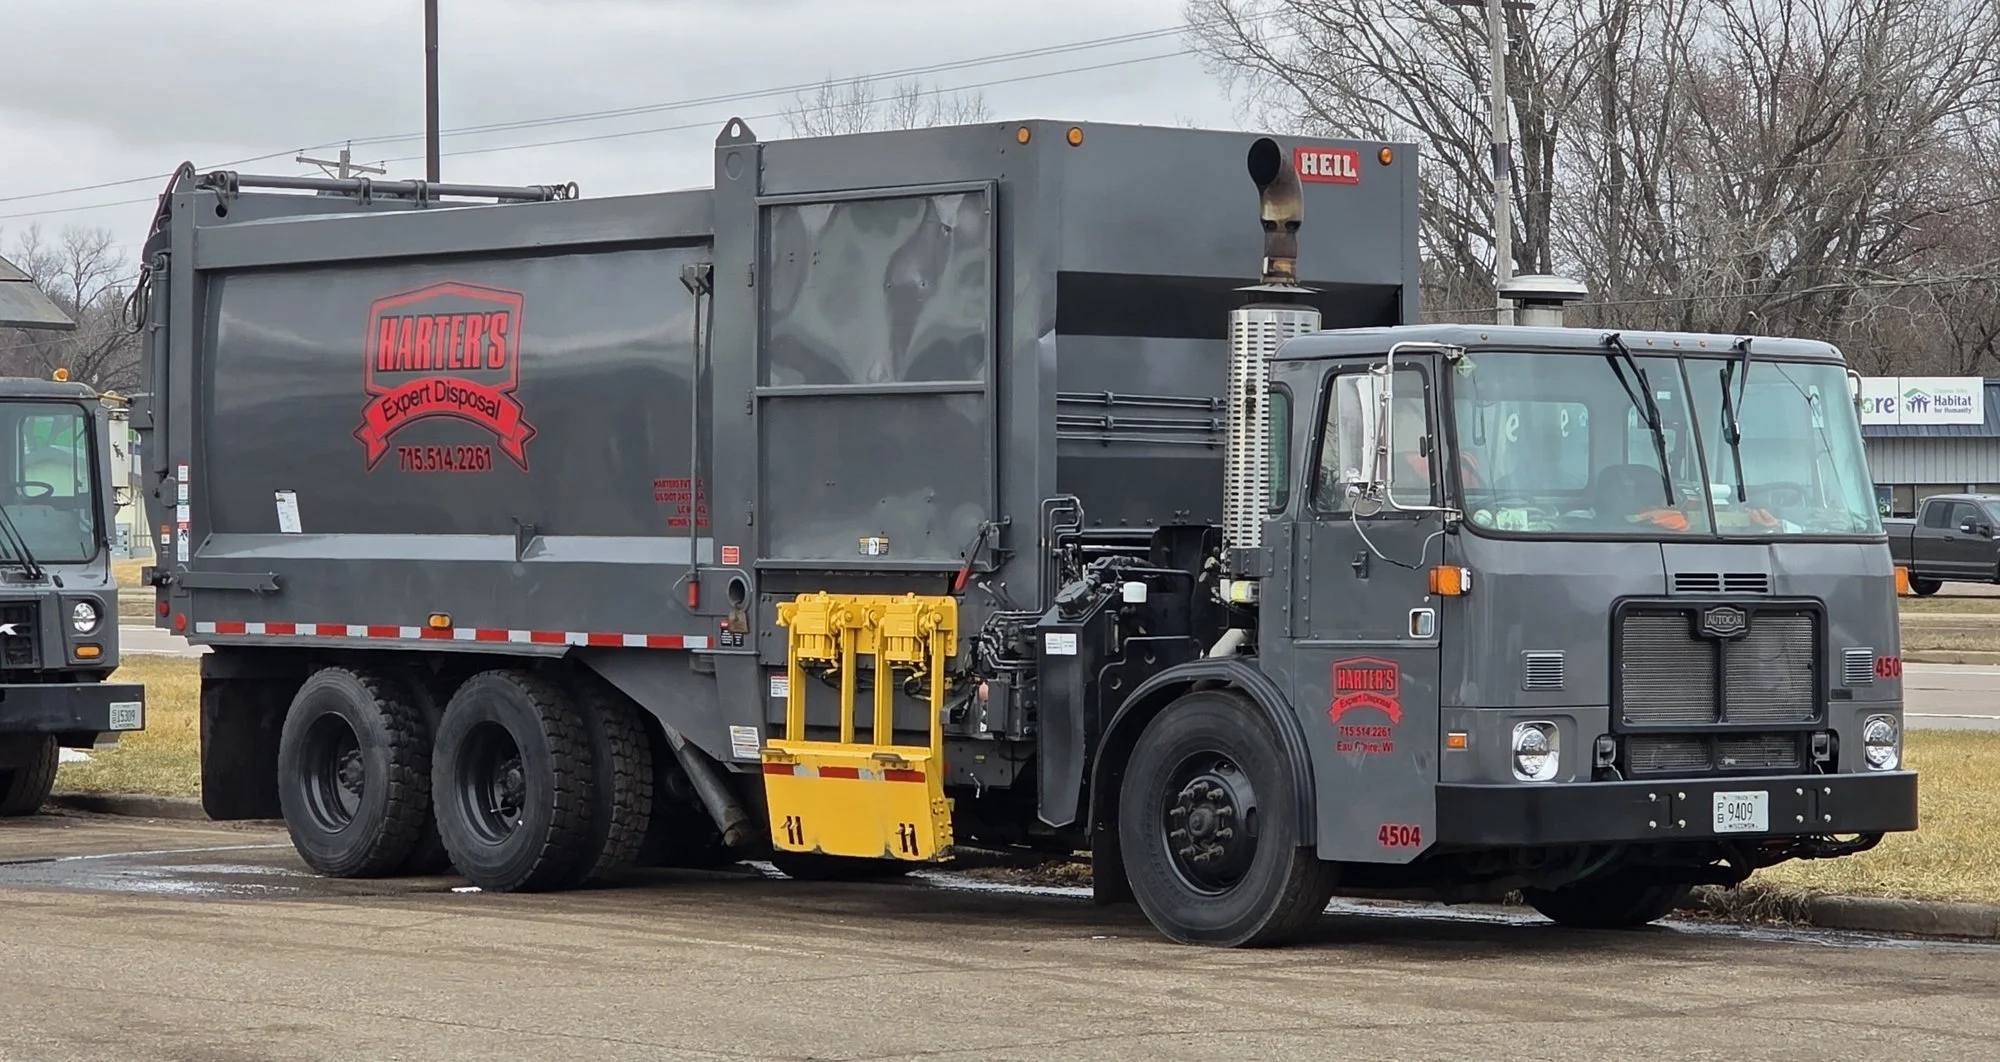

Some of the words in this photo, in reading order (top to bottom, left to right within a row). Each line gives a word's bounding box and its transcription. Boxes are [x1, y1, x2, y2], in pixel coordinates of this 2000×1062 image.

[1301, 152, 1357, 177] HEIL
[376, 311, 509, 372] HARTER'S
[381, 383, 432, 422] Expert
[434, 380, 502, 420] Disposal
[1934, 395, 1972, 406] Habitat
[398, 447, 492, 470] 715.514.2261
[1707, 614, 1743, 625] AUTOCAR
[1337, 669, 1395, 690] HARTER'S
[1337, 740, 1353, 752] Eau
[1382, 741, 1393, 752] WI
[1728, 802, 1753, 821] 9409
[1379, 825, 1420, 846] 4504
